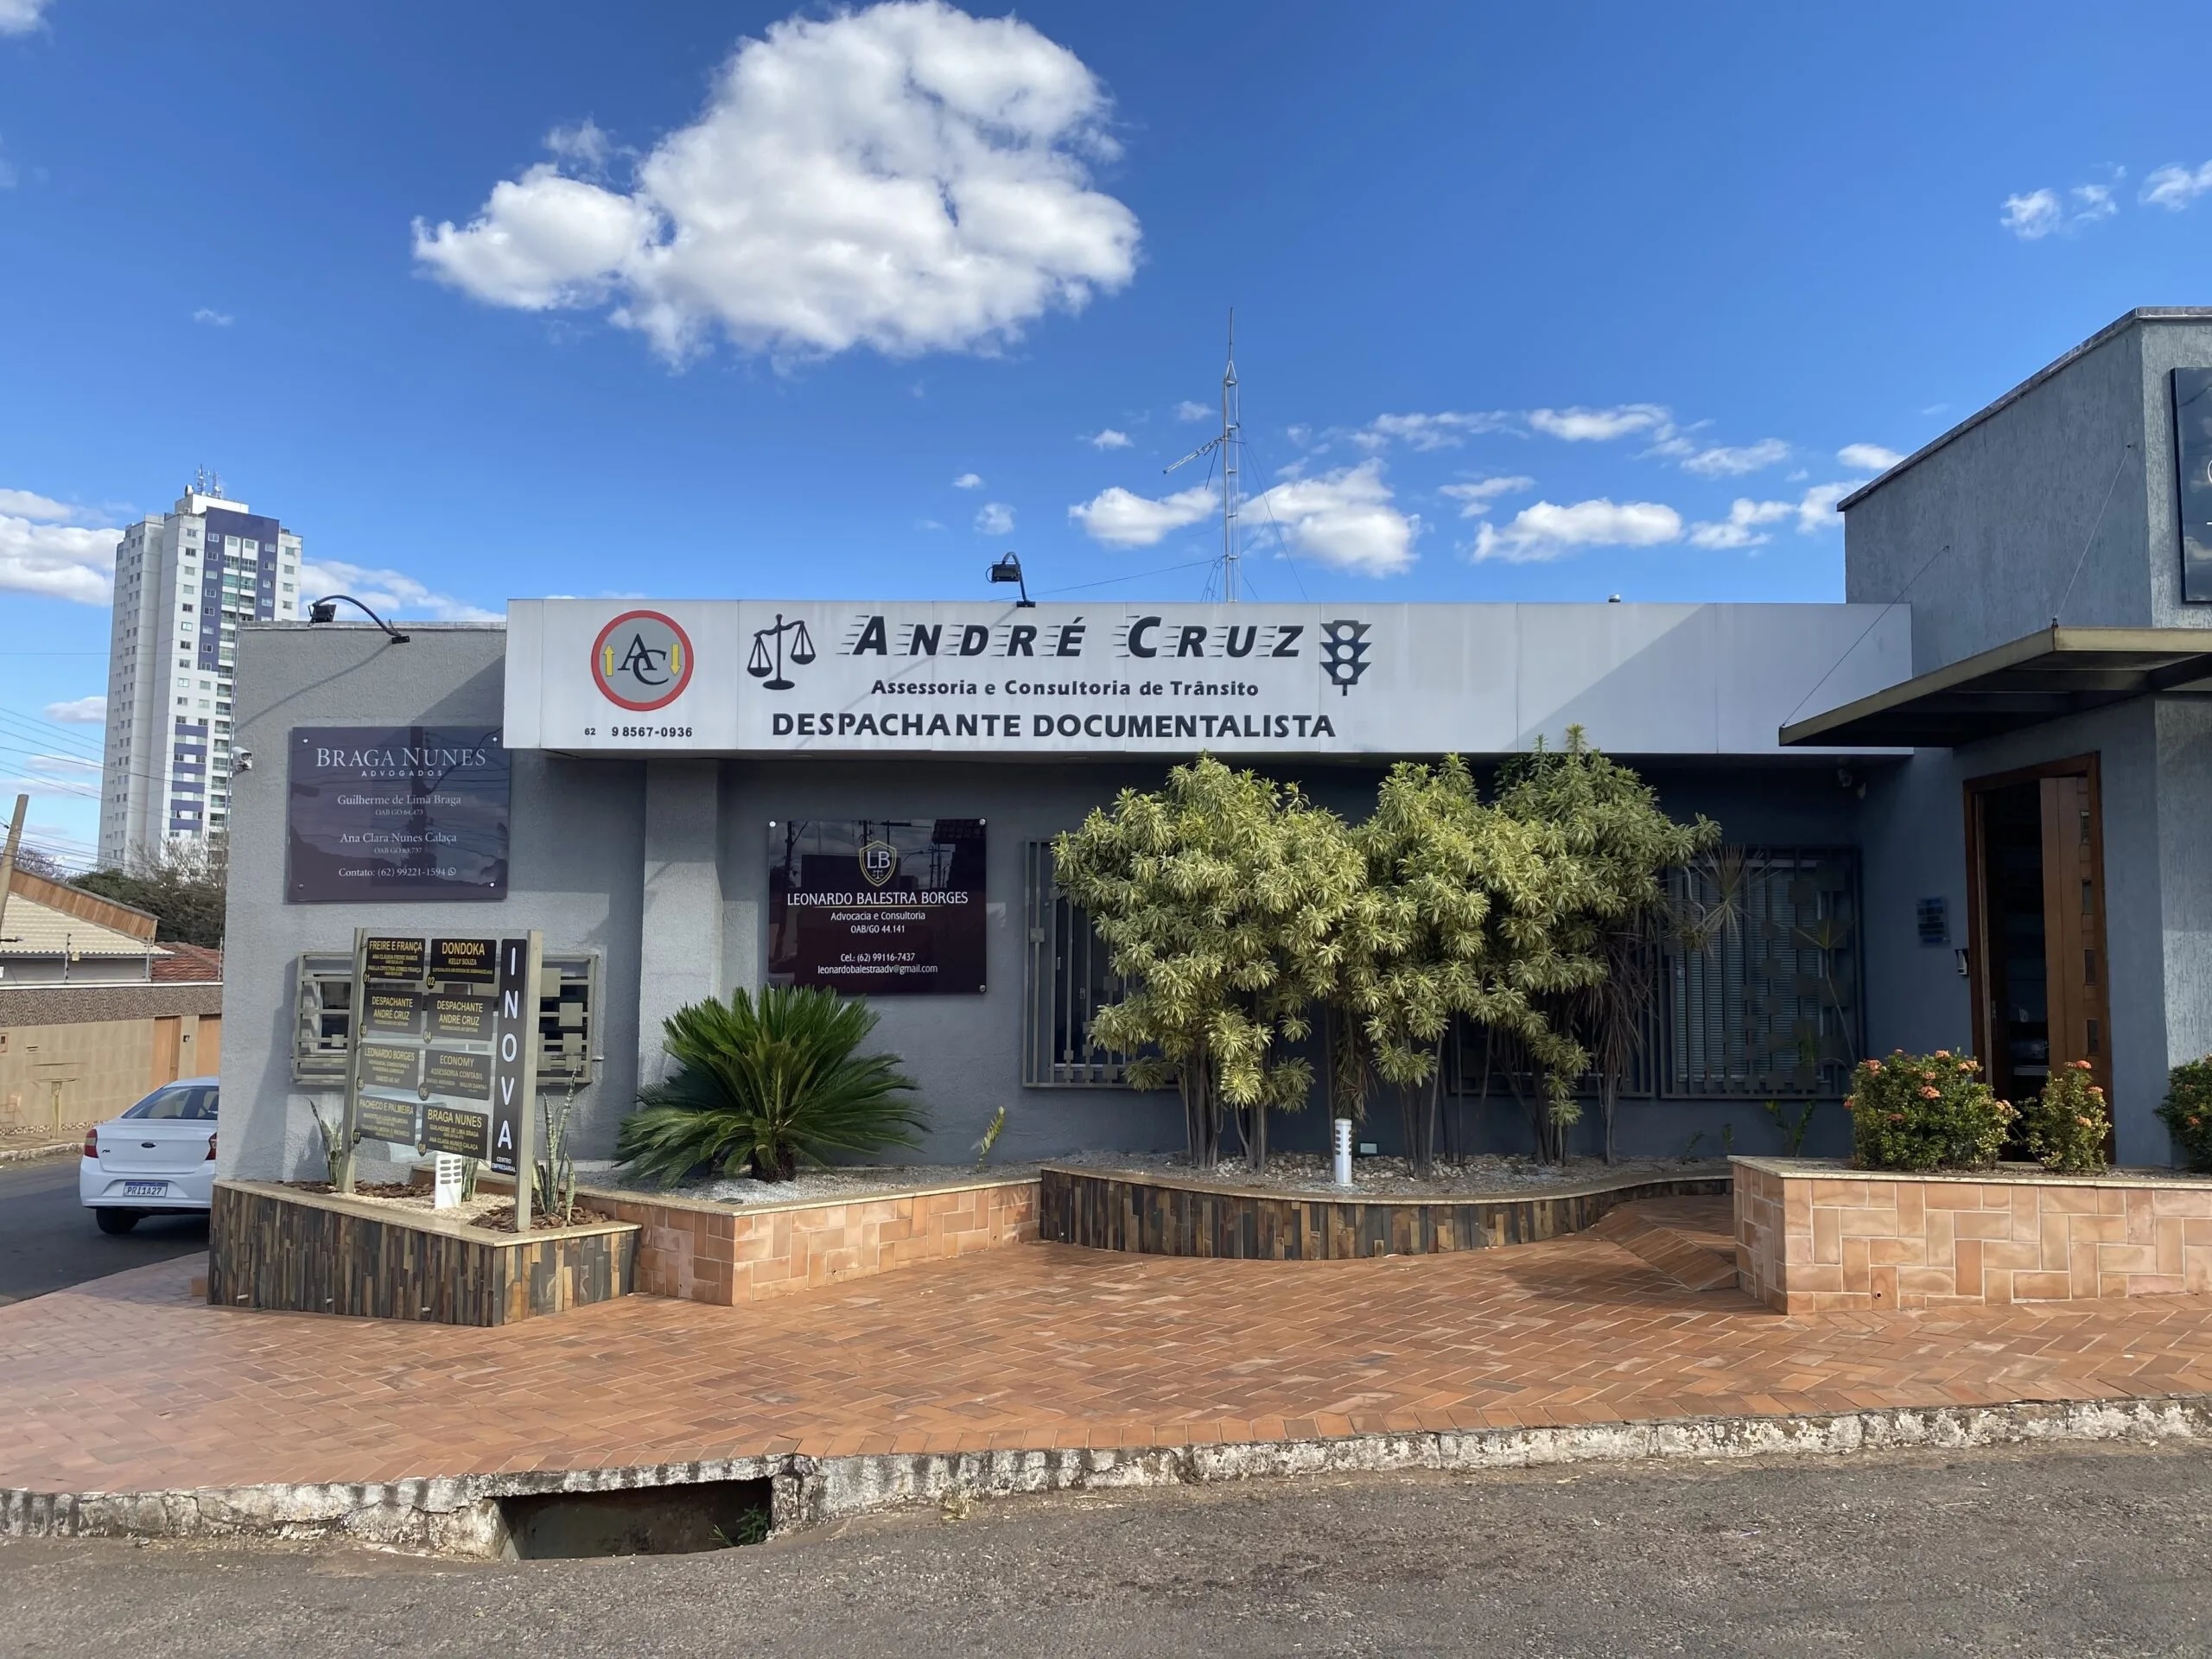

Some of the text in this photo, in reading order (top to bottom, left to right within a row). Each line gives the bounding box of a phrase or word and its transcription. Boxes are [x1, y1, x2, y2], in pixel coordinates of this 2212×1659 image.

[842, 615, 1305, 658] ANDRÉ CRUZ
[871, 679, 1259, 696] Assessoria e Consultoria de Trânsito
[584, 728, 596, 736] 62
[772, 713, 1337, 738] DESPACHANTE DOCUMENTALISTA
[316, 747, 486, 767] BRAGA NUNES
[361, 769, 443, 778] ADVOGADOS
[337, 794, 461, 807] Guilherme de Lima Braga
[340, 831, 457, 844] Ana Clara Nunes Calaça
[867, 851, 891, 869] LB
[339, 867, 446, 878] Contato: (62) 99221-1594
[787, 891, 969, 906] LEONARDO BALESTRA BORGES
[830, 912, 871, 921] Advocacia
[880, 911, 926, 920] Consultoria
[850, 925, 905, 934] OAB/GO 44.141
[369, 940, 423, 953] FREIRE E FRANÇA
[442, 942, 486, 956] DONDOKA
[857, 953, 871, 963] (62)
[873, 952, 916, 962] 99116-7437
[817, 964, 938, 975] leonardobalestraadv@gmail.com
[427, 976, 435, 986] 02
[372, 995, 413, 1008] DESPACHANTE
[436, 1000, 484, 1013] DESPACHANTE
[393, 1010, 410, 1020] CRUZ
[461, 1015, 480, 1027] CRUZ
[364, 1046, 415, 1062] LEONARDO BORGES
[440, 1054, 475, 1068] ECONOMY
[428, 1109, 482, 1128] BRAGA NUNES
